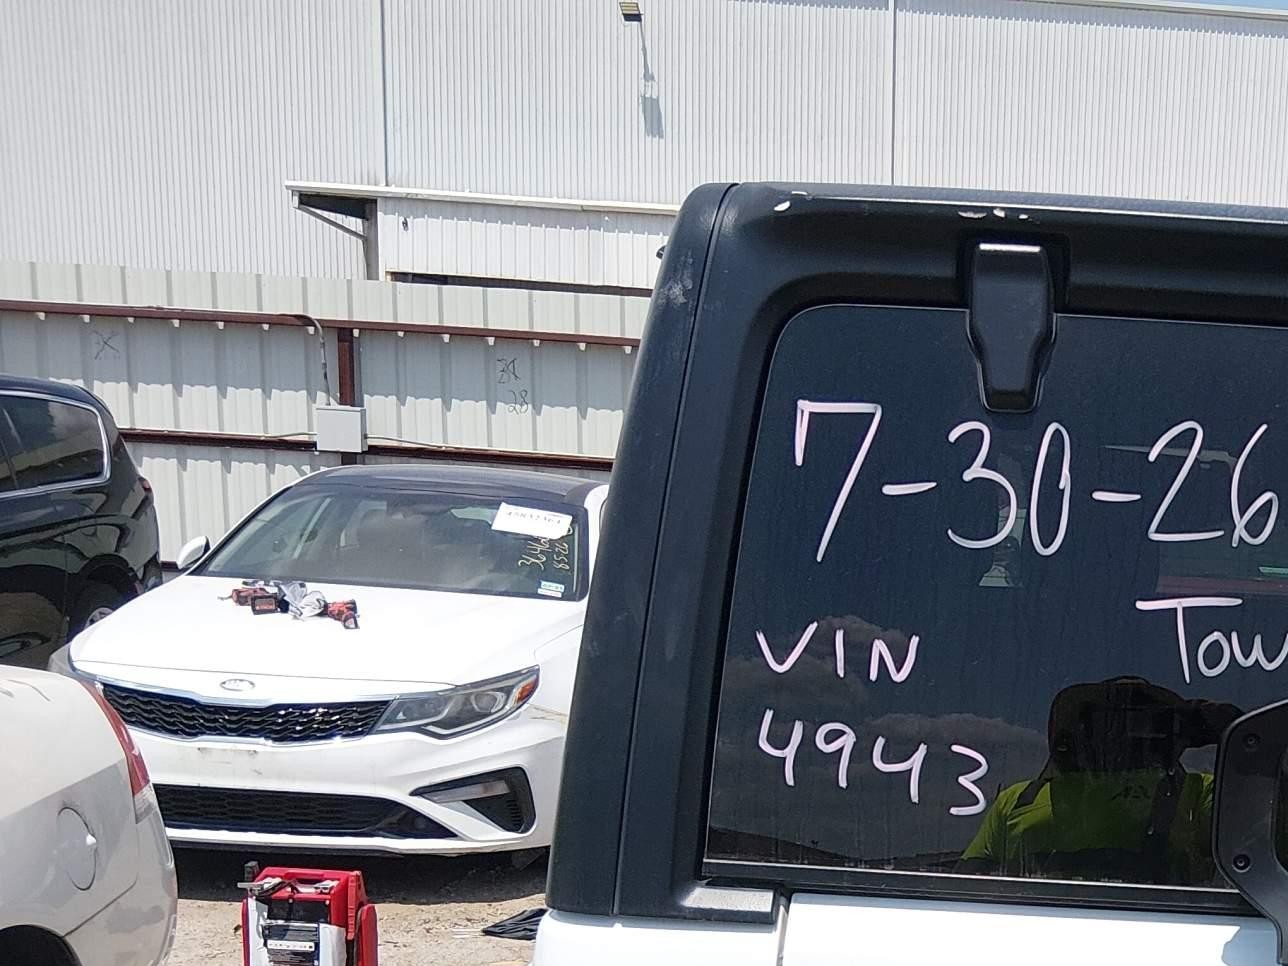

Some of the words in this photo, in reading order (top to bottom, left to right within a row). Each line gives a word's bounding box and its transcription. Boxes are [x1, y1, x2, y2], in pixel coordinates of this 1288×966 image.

[795, 399, 1279, 562] 7-30-26
[756, 622, 920, 683] VIN
[758, 709, 989, 816] 4943
